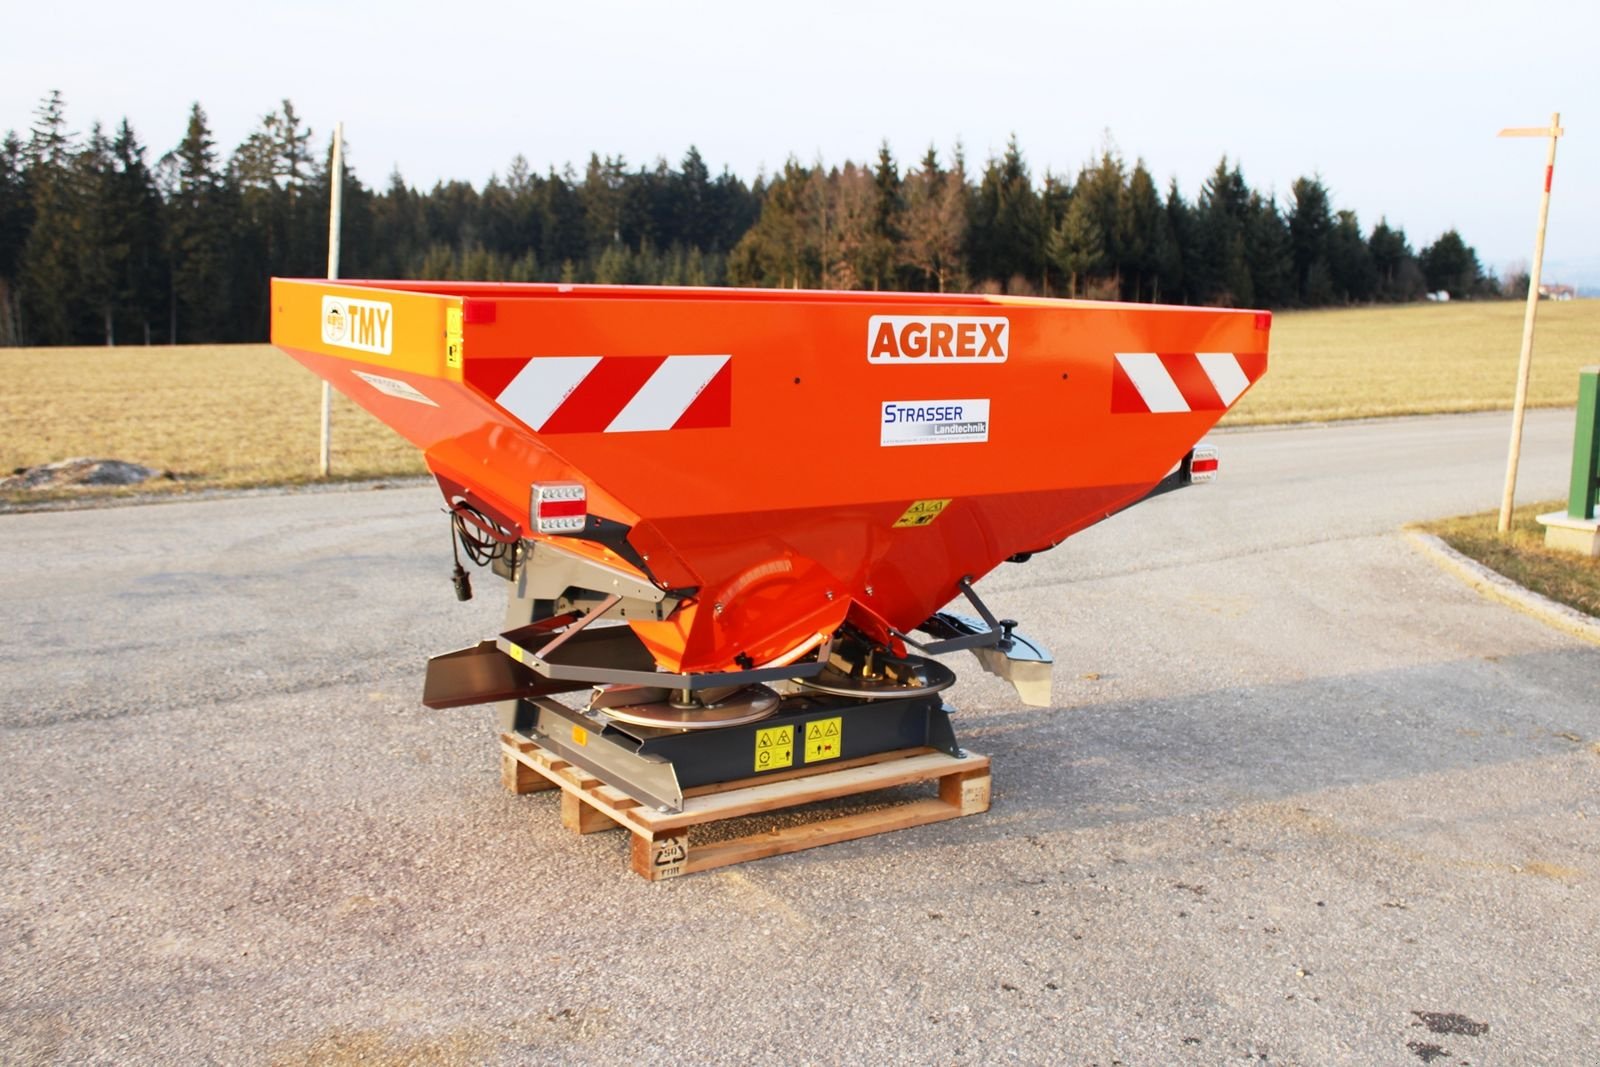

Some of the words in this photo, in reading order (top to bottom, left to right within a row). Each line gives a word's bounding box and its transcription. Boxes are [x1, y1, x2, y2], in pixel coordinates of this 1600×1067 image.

[348, 304, 390, 348] TMY
[870, 322, 1006, 358] AGREX
[884, 404, 963, 423] STRASSER
[934, 422, 986, 435] Landtechnik
